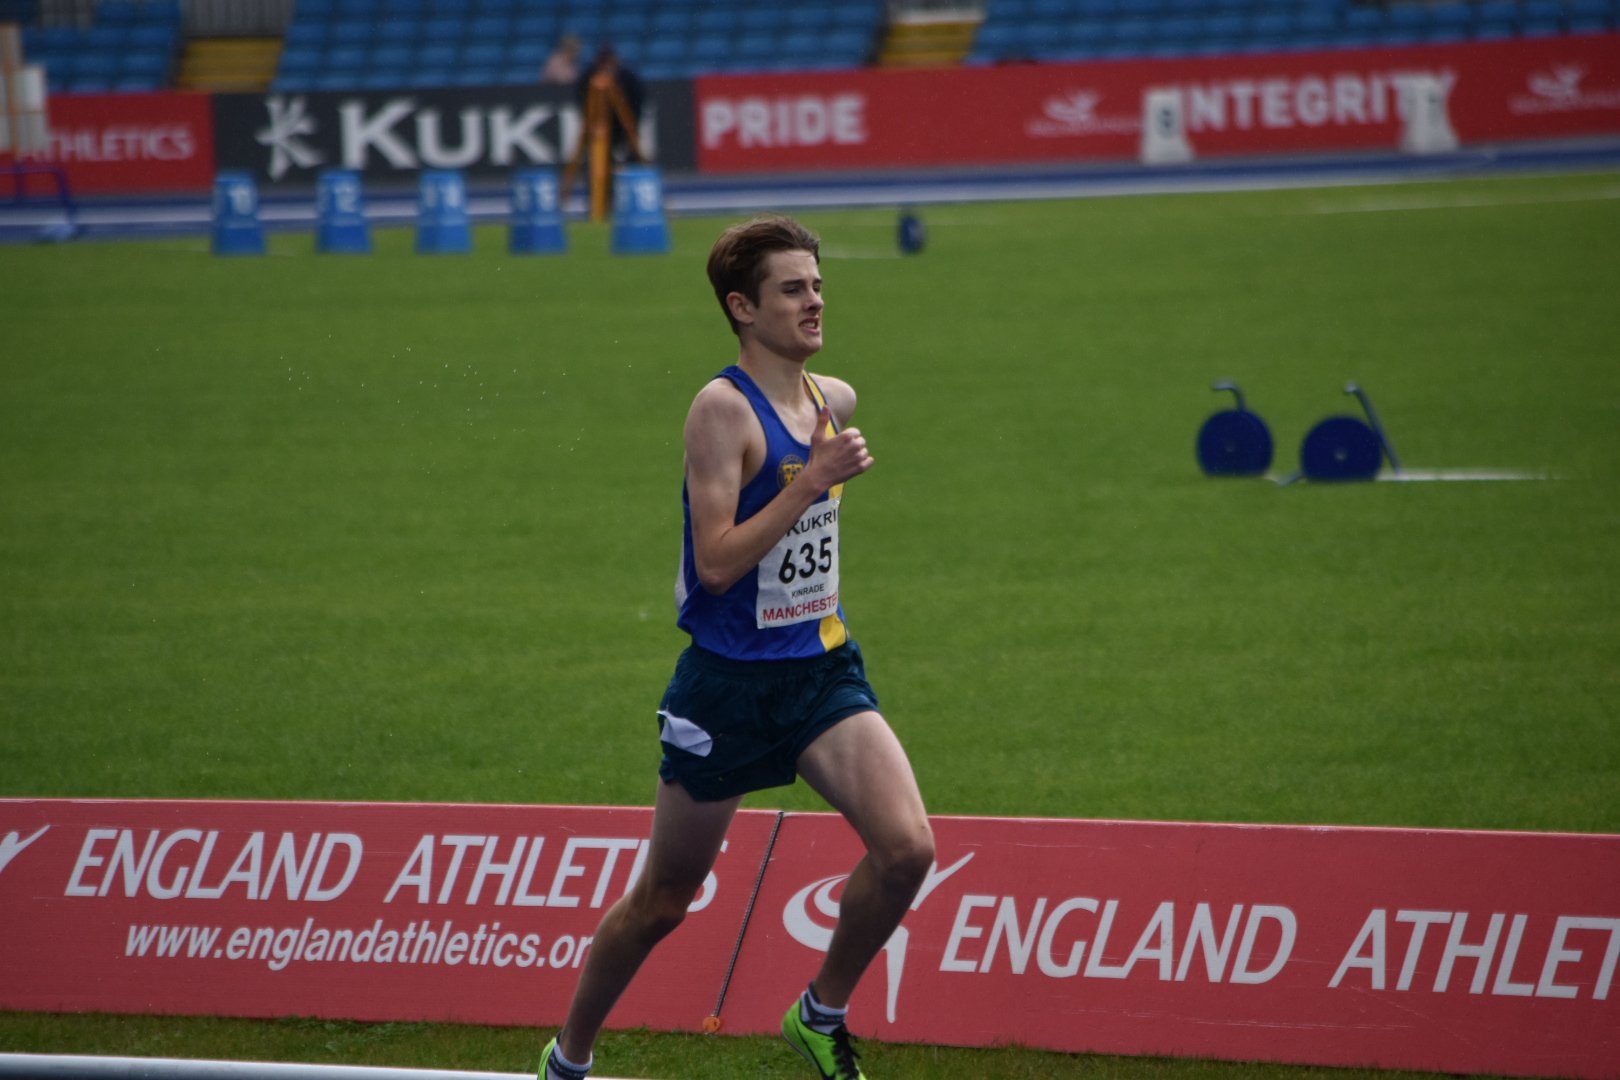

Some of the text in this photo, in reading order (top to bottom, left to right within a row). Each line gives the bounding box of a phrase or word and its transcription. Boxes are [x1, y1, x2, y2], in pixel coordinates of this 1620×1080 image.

[32, 126, 194, 163] THLETICS
[702, 94, 867, 149] PRIDE
[778, 536, 832, 584] 635
[762, 592, 839, 622] MANCHESTE
[791, 583, 825, 599] KINRADE
[64, 829, 363, 901] ENGLAND
[125, 917, 595, 972] www.englandathletics.or
[938, 894, 1298, 985] ENGLAND
